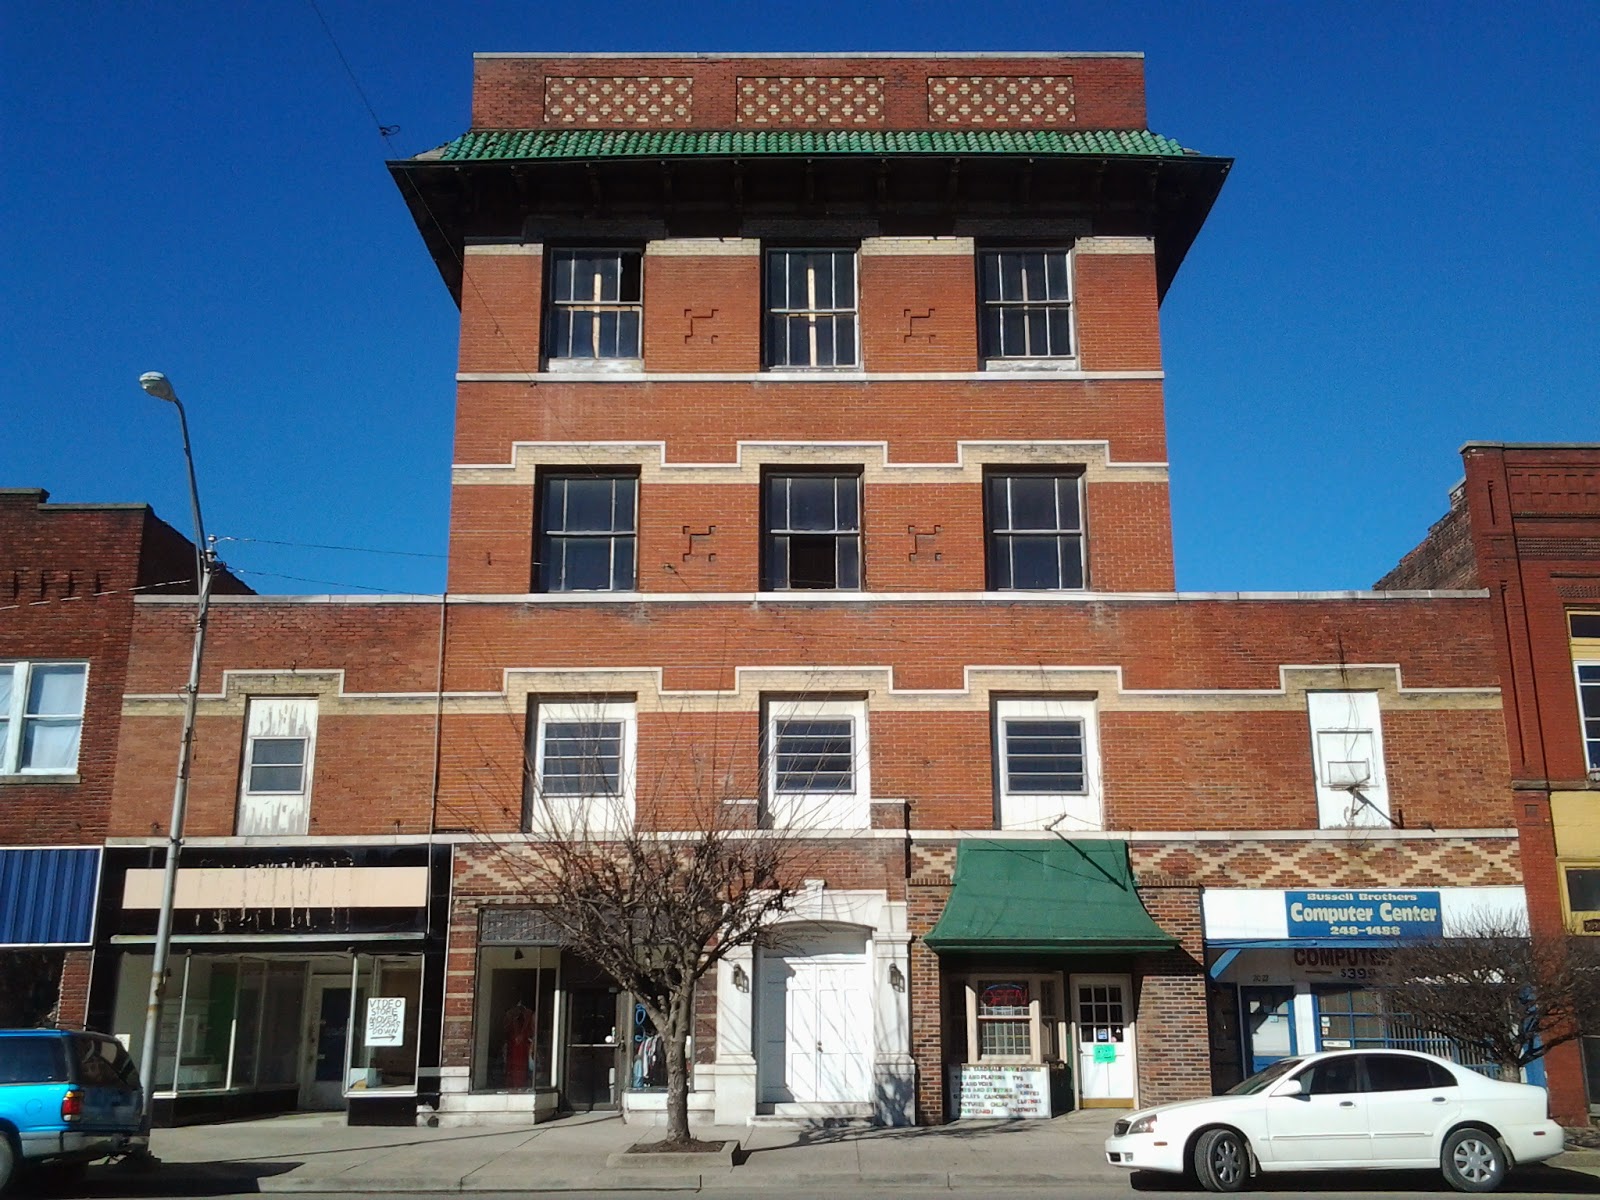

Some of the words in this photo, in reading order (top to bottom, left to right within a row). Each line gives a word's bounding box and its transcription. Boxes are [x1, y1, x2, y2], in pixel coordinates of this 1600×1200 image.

[1359, 893, 1417, 901] Brothers
[1290, 902, 1373, 924] Computer
[1380, 902, 1437, 922] Center
[369, 999, 402, 1009] VIDEO
[371, 1008, 398, 1016] STORE
